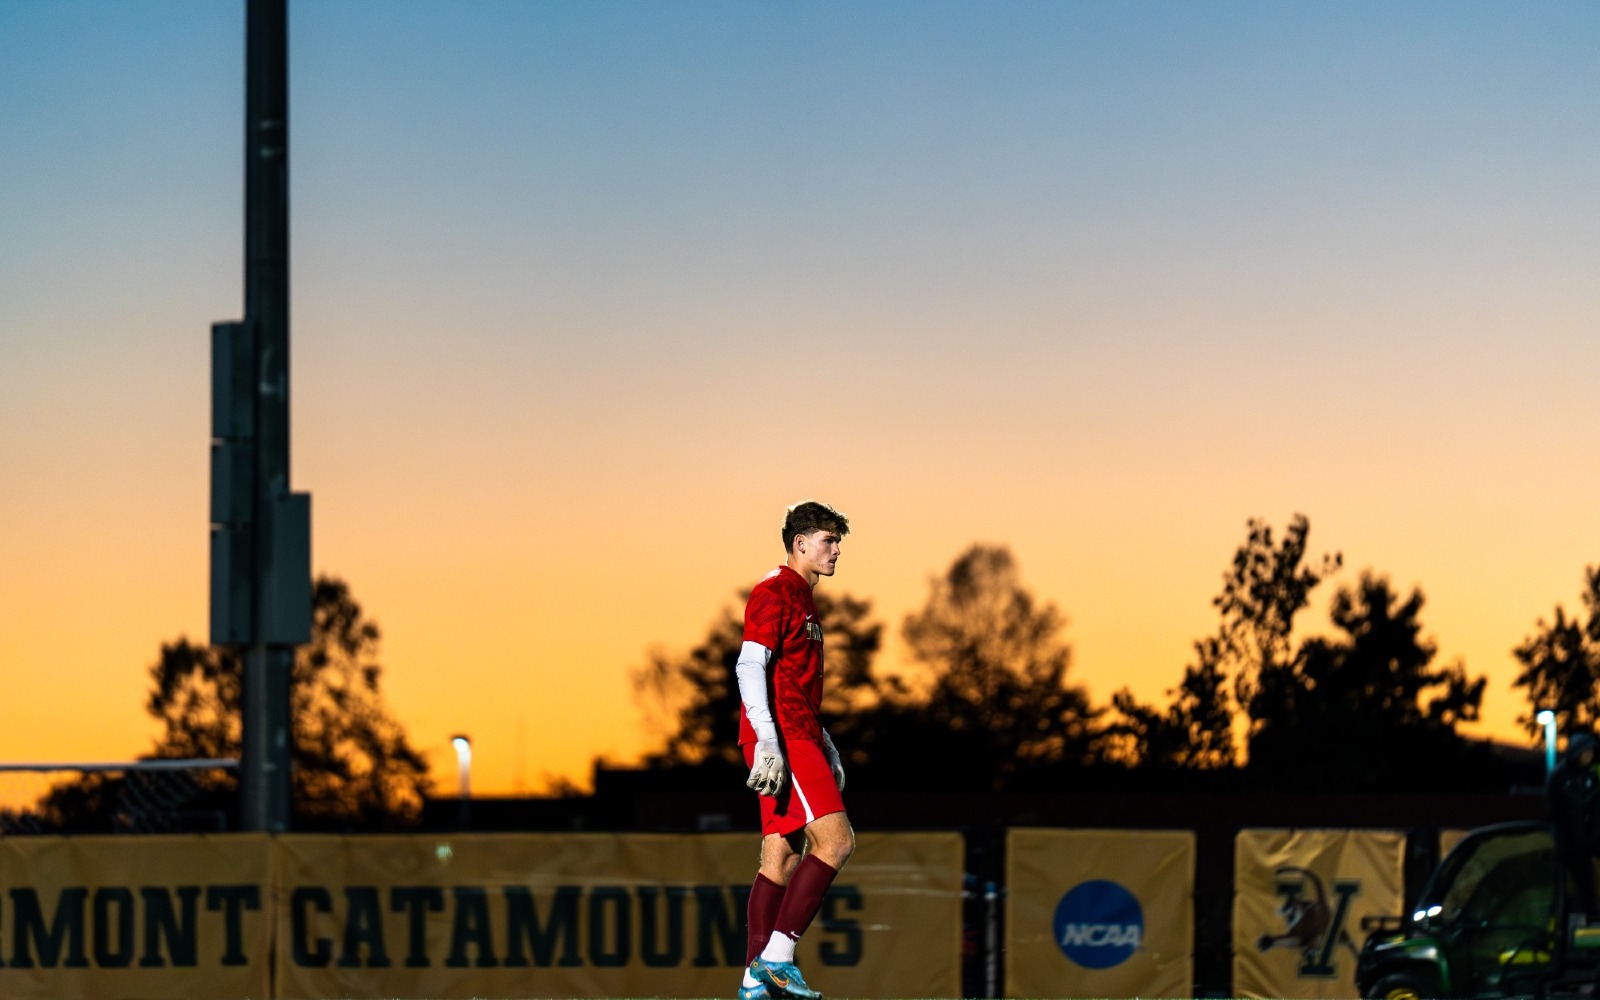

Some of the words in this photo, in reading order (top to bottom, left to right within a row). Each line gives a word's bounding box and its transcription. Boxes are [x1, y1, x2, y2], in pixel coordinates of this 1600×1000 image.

[0, 884, 261, 968] MONT
[291, 885, 862, 968] CATAMOUNS
[1062, 924, 1141, 947] NCAA
